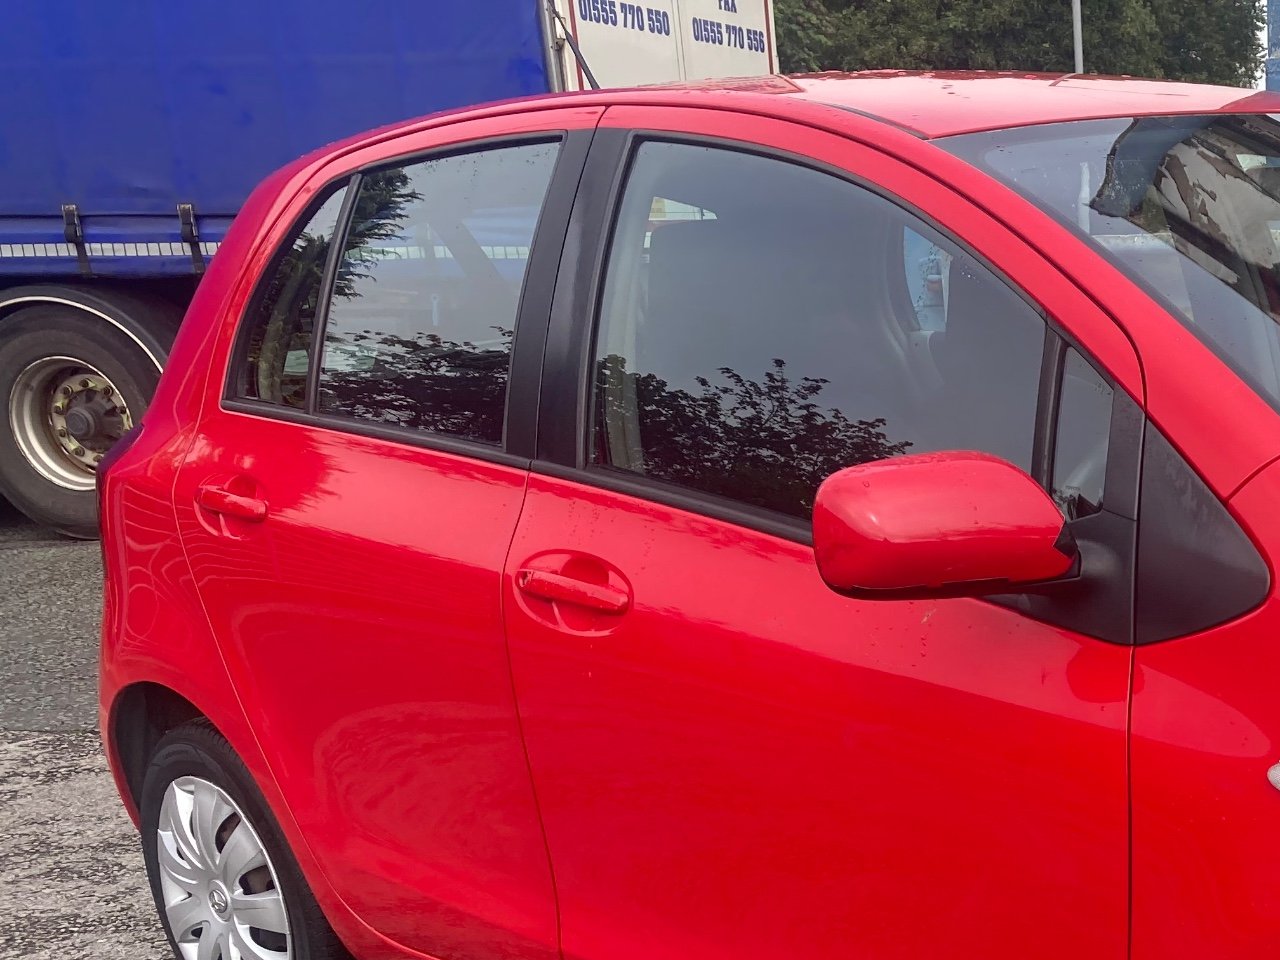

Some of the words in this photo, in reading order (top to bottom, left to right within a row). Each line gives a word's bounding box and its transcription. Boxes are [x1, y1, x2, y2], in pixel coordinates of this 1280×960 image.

[578, 0, 617, 26] 01555
[620, 2, 645, 31] 770
[646, 8, 670, 36] 550
[692, 17, 723, 45] 01555
[725, 24, 744, 49] 770
[746, 28, 765, 53] 556
